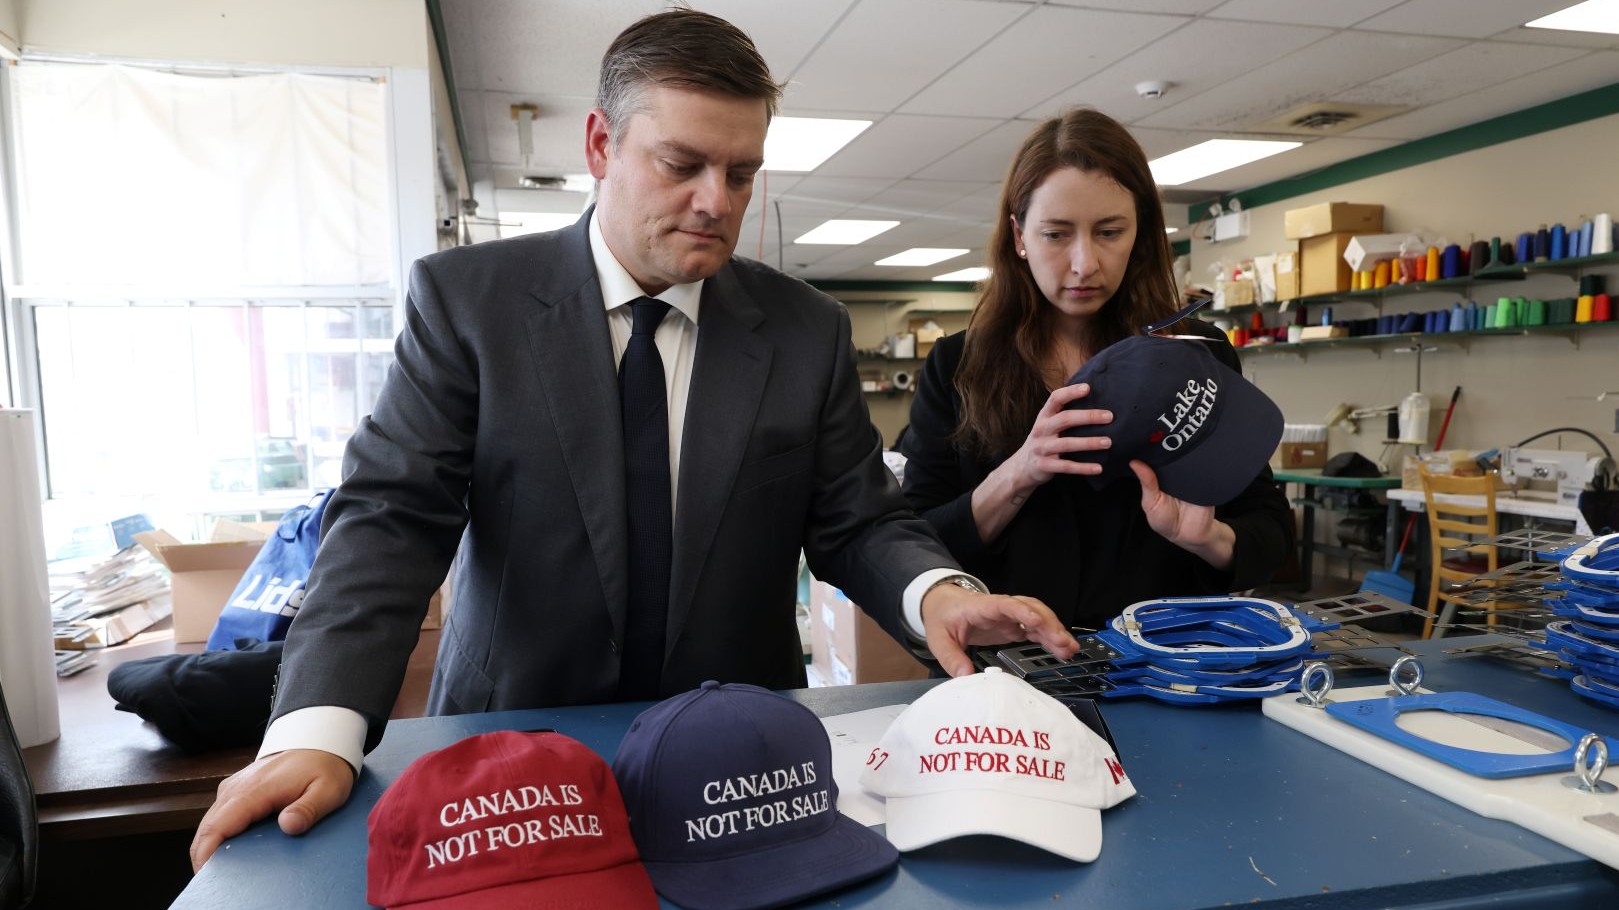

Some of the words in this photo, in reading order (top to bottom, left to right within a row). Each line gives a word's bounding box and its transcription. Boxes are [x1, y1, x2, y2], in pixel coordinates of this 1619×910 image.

[1157, 379, 1200, 432] Lake
[1161, 378, 1218, 451] Ontario
[935, 726, 1030, 748] CANADA
[1032, 731, 1051, 751] IS
[703, 765, 801, 805] CANADA
[801, 761, 817, 785] IS
[919, 752, 961, 774] NOT
[964, 752, 1012, 773] FOR
[1016, 754, 1066, 781] SALE
[439, 784, 560, 828] CANADA
[559, 784, 583, 806] IS
[685, 810, 741, 842] NOT
[743, 801, 792, 831] FOR
[792, 790, 829, 821] SALE
[424, 829, 481, 869] NOT
[485, 820, 548, 851] FOR
[549, 814, 603, 840] SALE
